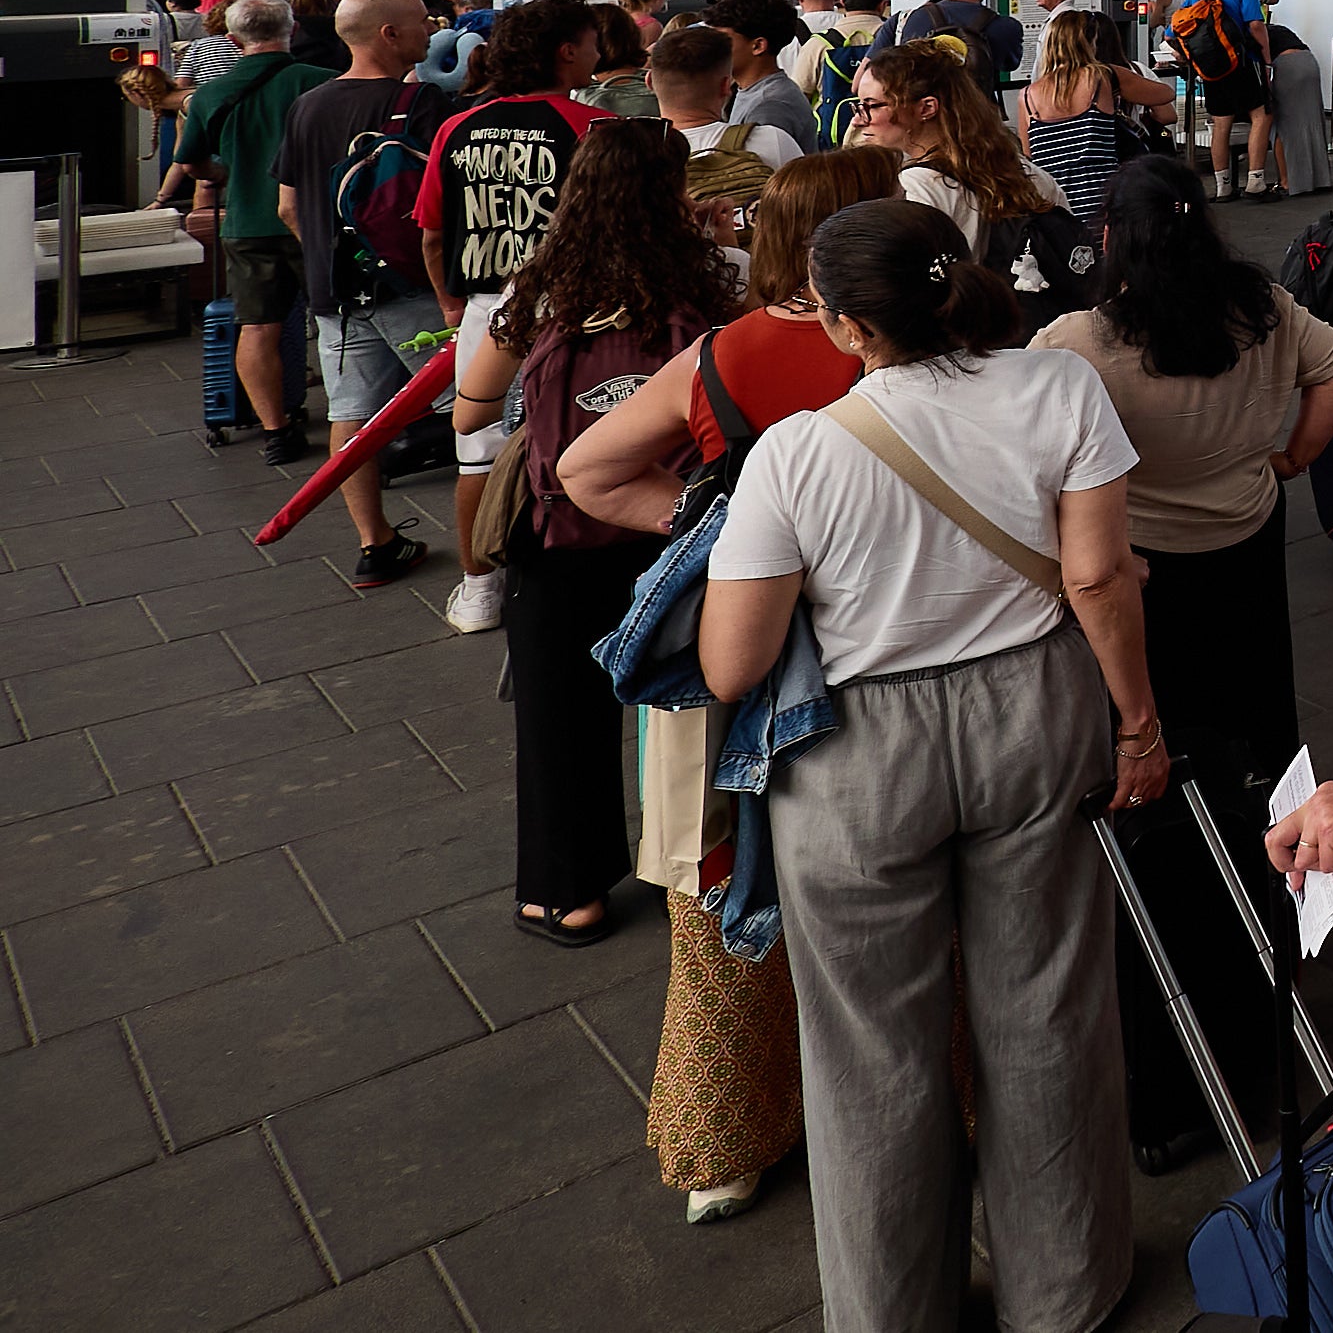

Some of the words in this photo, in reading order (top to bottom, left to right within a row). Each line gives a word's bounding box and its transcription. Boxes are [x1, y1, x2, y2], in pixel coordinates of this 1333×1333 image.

[471, 128, 500, 141] UNITED
[500, 129, 513, 140] BY
[513, 129, 528, 141] THE
[464, 142, 556, 185] WORLD
